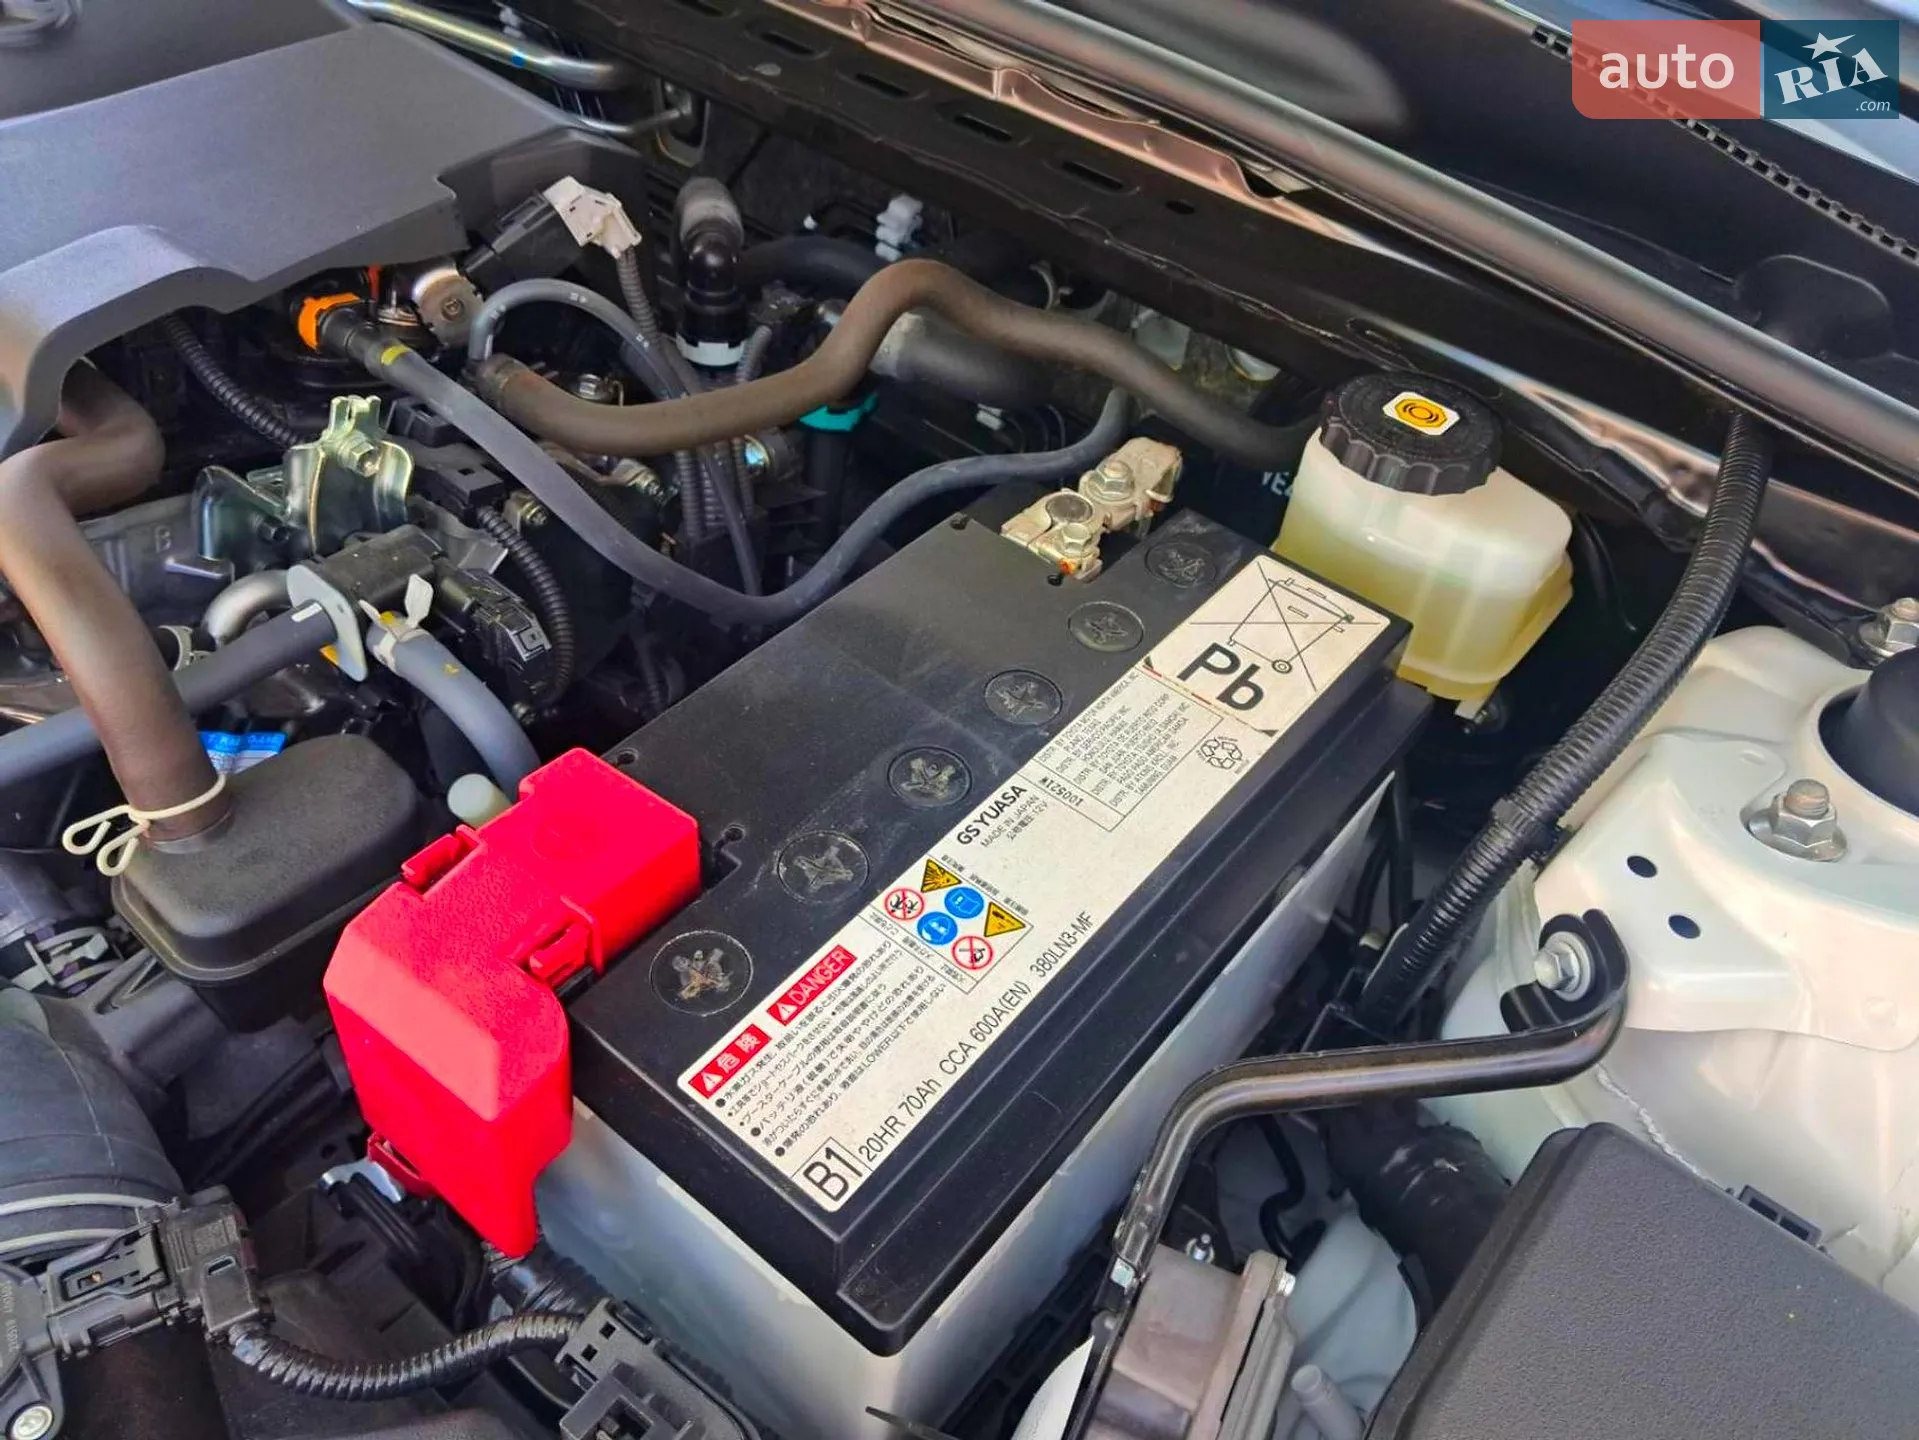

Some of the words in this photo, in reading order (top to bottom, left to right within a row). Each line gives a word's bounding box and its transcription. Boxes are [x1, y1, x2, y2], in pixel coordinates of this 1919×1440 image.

[1177, 643, 1266, 712] Pb
[953, 823, 982, 846] GS
[971, 782, 1027, 829] YUASA
[978, 824, 1006, 848] MADE
[1000, 816, 1015, 827] IN
[1011, 794, 1039, 818] JAPAN
[1029, 800, 1049, 816] 12V
[786, 947, 853, 1006] DANGER
[856, 1113, 906, 1162] 20HR
[897, 1074, 943, 1118] 70Ah
[935, 1037, 977, 1077] CCA
[966, 978, 1034, 1044] 600A(EN)
[1027, 909, 1099, 979] 380LN3-MF
[800, 1144, 864, 1204] B1
